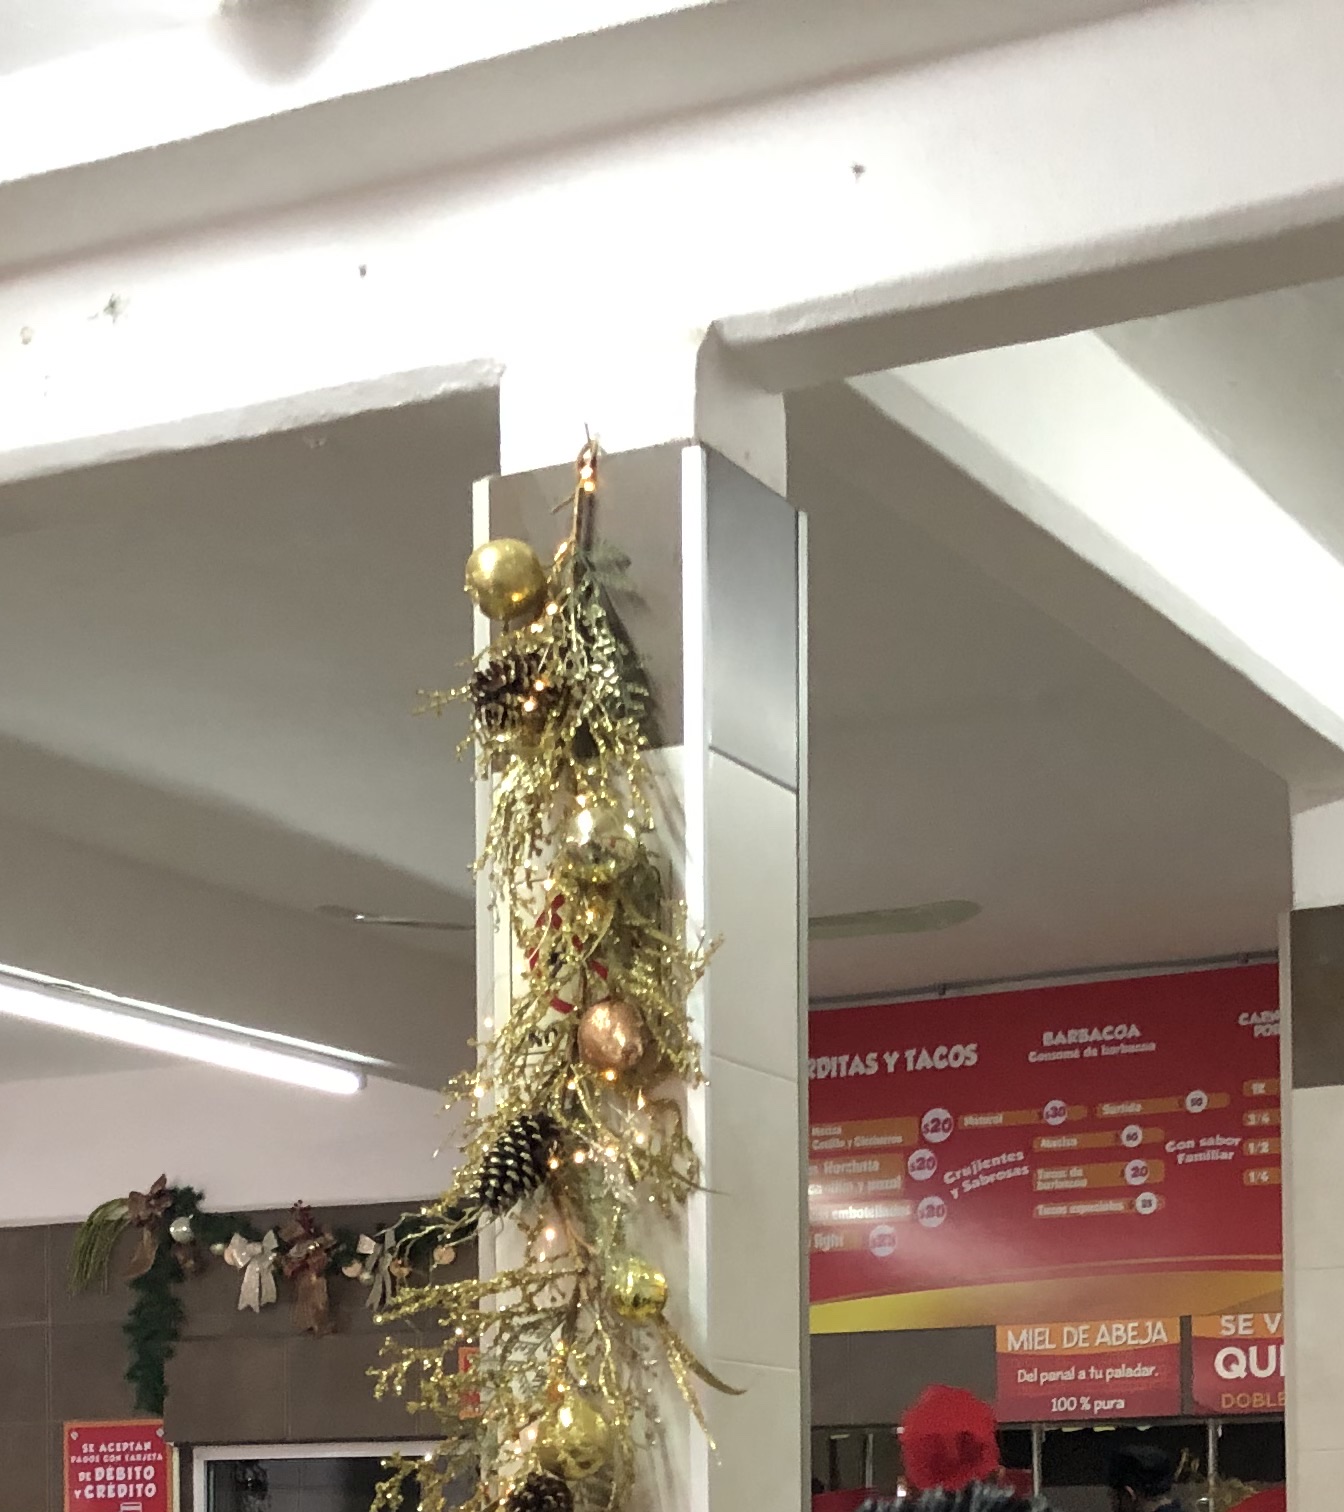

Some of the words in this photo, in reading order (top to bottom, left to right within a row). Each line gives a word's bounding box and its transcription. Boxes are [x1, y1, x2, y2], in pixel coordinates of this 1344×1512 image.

[1042, 1024, 1142, 1047] BARBACOA
[883, 1051, 900, 1074] Y
[905, 1043, 978, 1072] TACOS
[922, 1117, 953, 1135] $20
[1247, 1112, 1270, 1126] 3/4
[1165, 1139, 1196, 1153] Con
[1199, 1134, 1242, 1148] sabor
[1248, 1141, 1270, 1154] 1/2
[910, 1156, 936, 1173] $20
[1176, 1149, 1235, 1165] Familiar
[942, 1151, 1025, 1185] Crujientes
[1130, 1165, 1148, 1179] 20
[1248, 1170, 1269, 1183] 1/4
[949, 1187, 959, 1200] y
[961, 1165, 1030, 1193] Sabrosas
[1220, 1313, 1255, 1336] SE
[1007, 1327, 1056, 1351] MIEL
[1063, 1324, 1091, 1349] DE
[1095, 1320, 1169, 1347] ABEJA
[1017, 1368, 1038, 1384] Del
[1039, 1364, 1075, 1386] panal
[1077, 1367, 1087, 1381] a
[1089, 1364, 1104, 1381] tu
[1106, 1361, 1159, 1384] paladar.
[1051, 1396, 1077, 1413] 100
[1079, 1395, 1092, 1410] %
[1094, 1396, 1125, 1414] pura
[81, 1443, 95, 1454] SE
[99, 1441, 152, 1453] ACEPTAN
[70, 1454, 100, 1464] PAGOS
[102, 1453, 122, 1463] CON
[124, 1452, 164, 1462] TARJETA
[78, 1471, 92, 1482] DE
[94, 1464, 155, 1482] DÉBITO
[74, 1489, 82, 1499] Y
[84, 1482, 157, 1499] CRÉDITO
